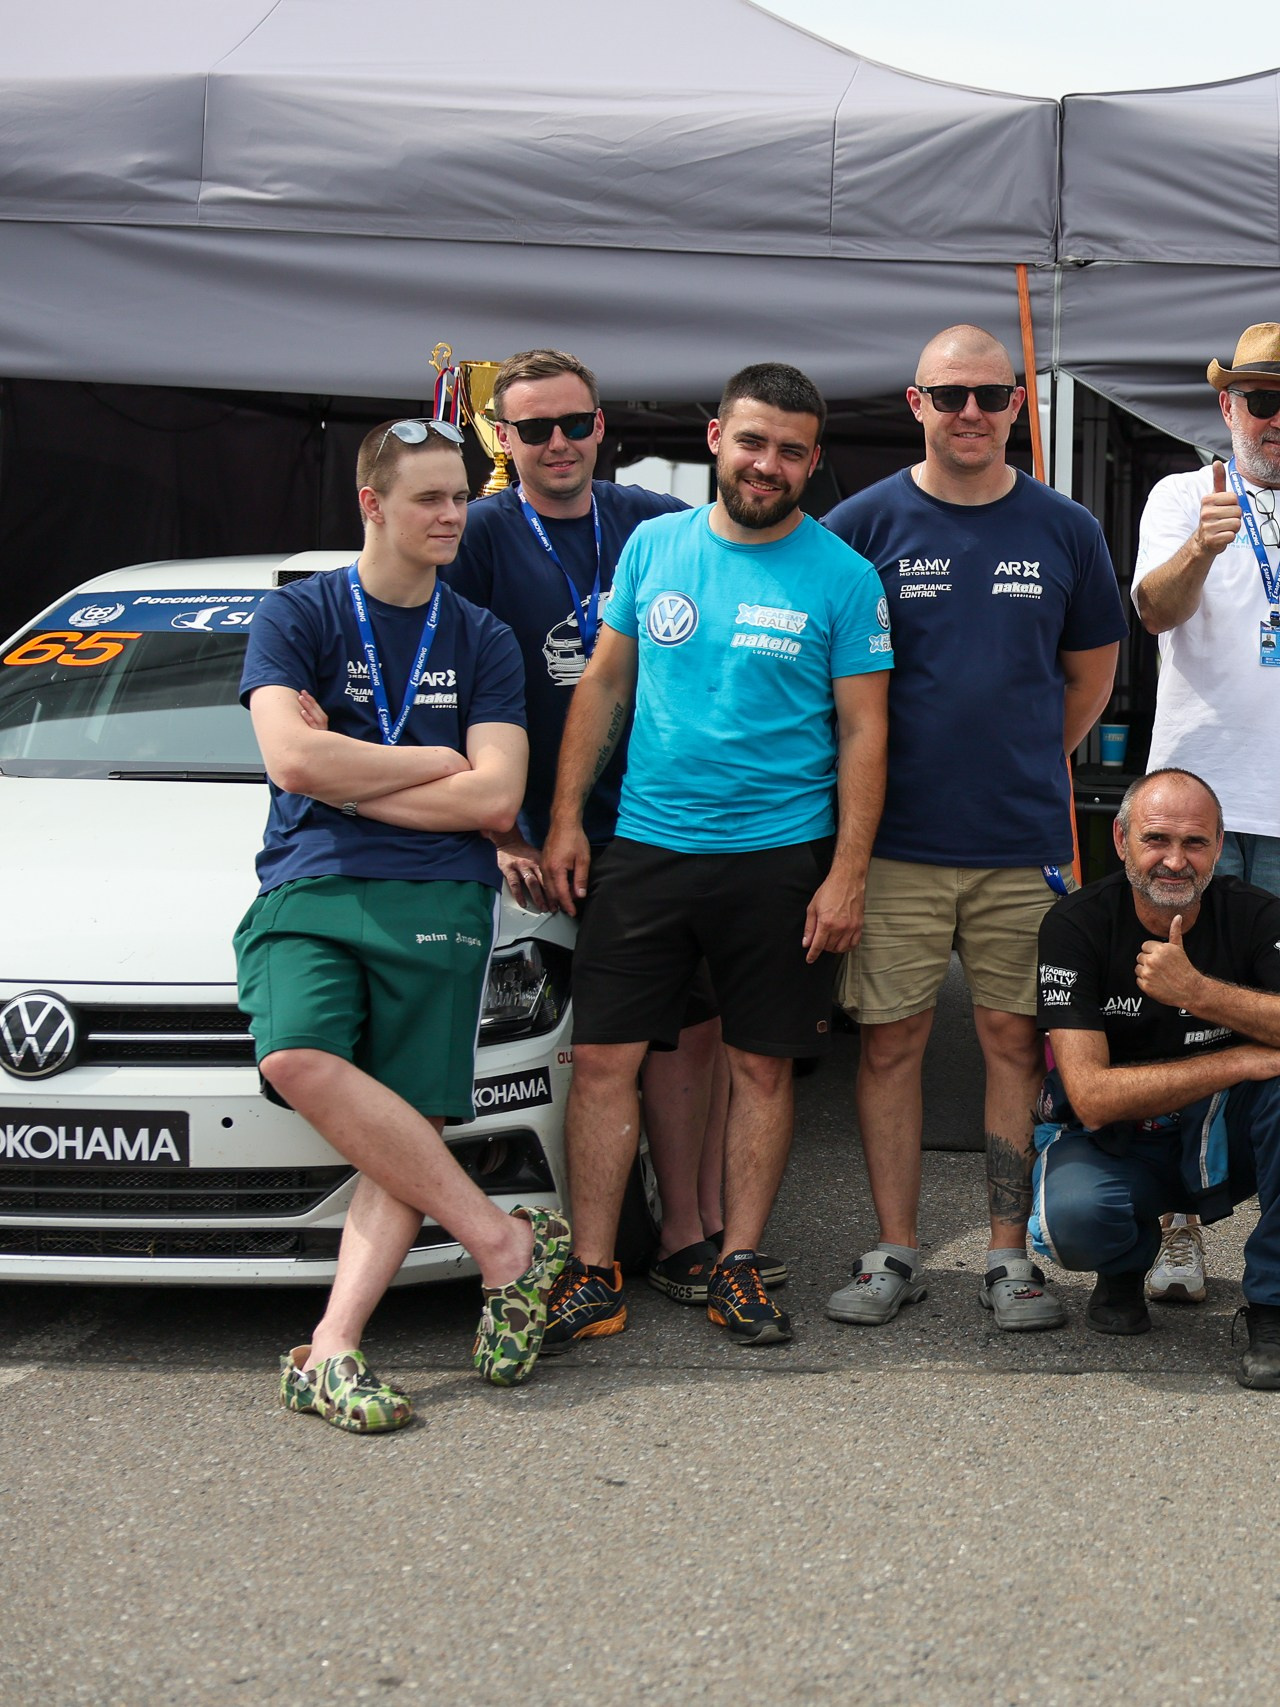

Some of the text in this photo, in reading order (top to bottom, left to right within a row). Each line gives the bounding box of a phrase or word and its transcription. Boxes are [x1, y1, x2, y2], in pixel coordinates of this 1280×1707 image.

[992, 582, 1043, 594] pakelo
[133, 595, 255, 605] Российская
[759, 610, 805, 623] ACADEMY
[757, 617, 803, 632] RALLY
[3, 632, 143, 666] 65
[730, 633, 801, 655] pakelo
[414, 693, 458, 705] pakel
[1104, 996, 1142, 1012] AMV
[473, 1076, 548, 1108] KOHAMA
[0, 1125, 181, 1162] KOHAMA
